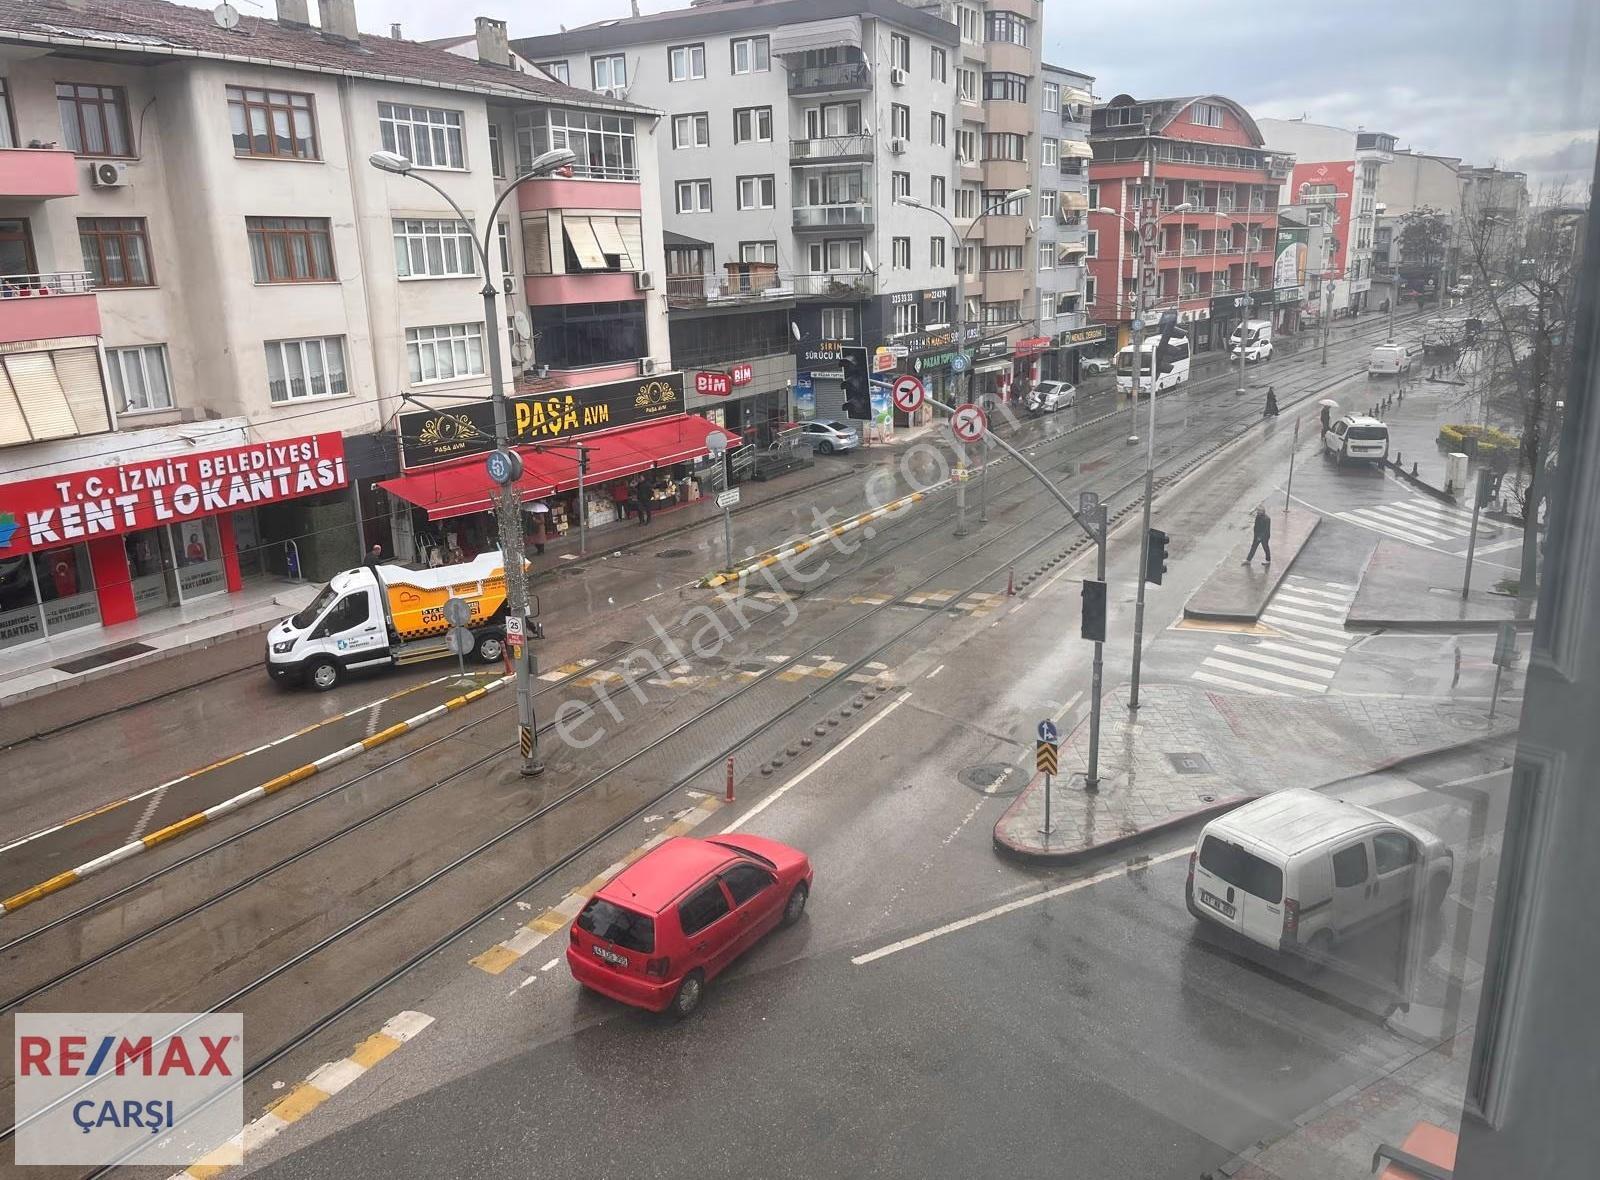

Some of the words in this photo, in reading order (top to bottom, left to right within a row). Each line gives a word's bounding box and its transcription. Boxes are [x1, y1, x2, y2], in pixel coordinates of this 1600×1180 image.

[697, 374, 726, 393] BİM
[734, 365, 751, 383] BİM
[515, 395, 578, 437] PAŞA
[584, 404, 609, 426] AVM
[452, 442, 465, 450] AVM
[55, 476, 114, 503] T.C.
[119, 458, 188, 493] İZMİT
[199, 436, 320, 479] BELEDİYESİ
[26, 493, 140, 546] KENT
[152, 457, 345, 521] LOKANTASI
[510, 621, 519, 630] 25
